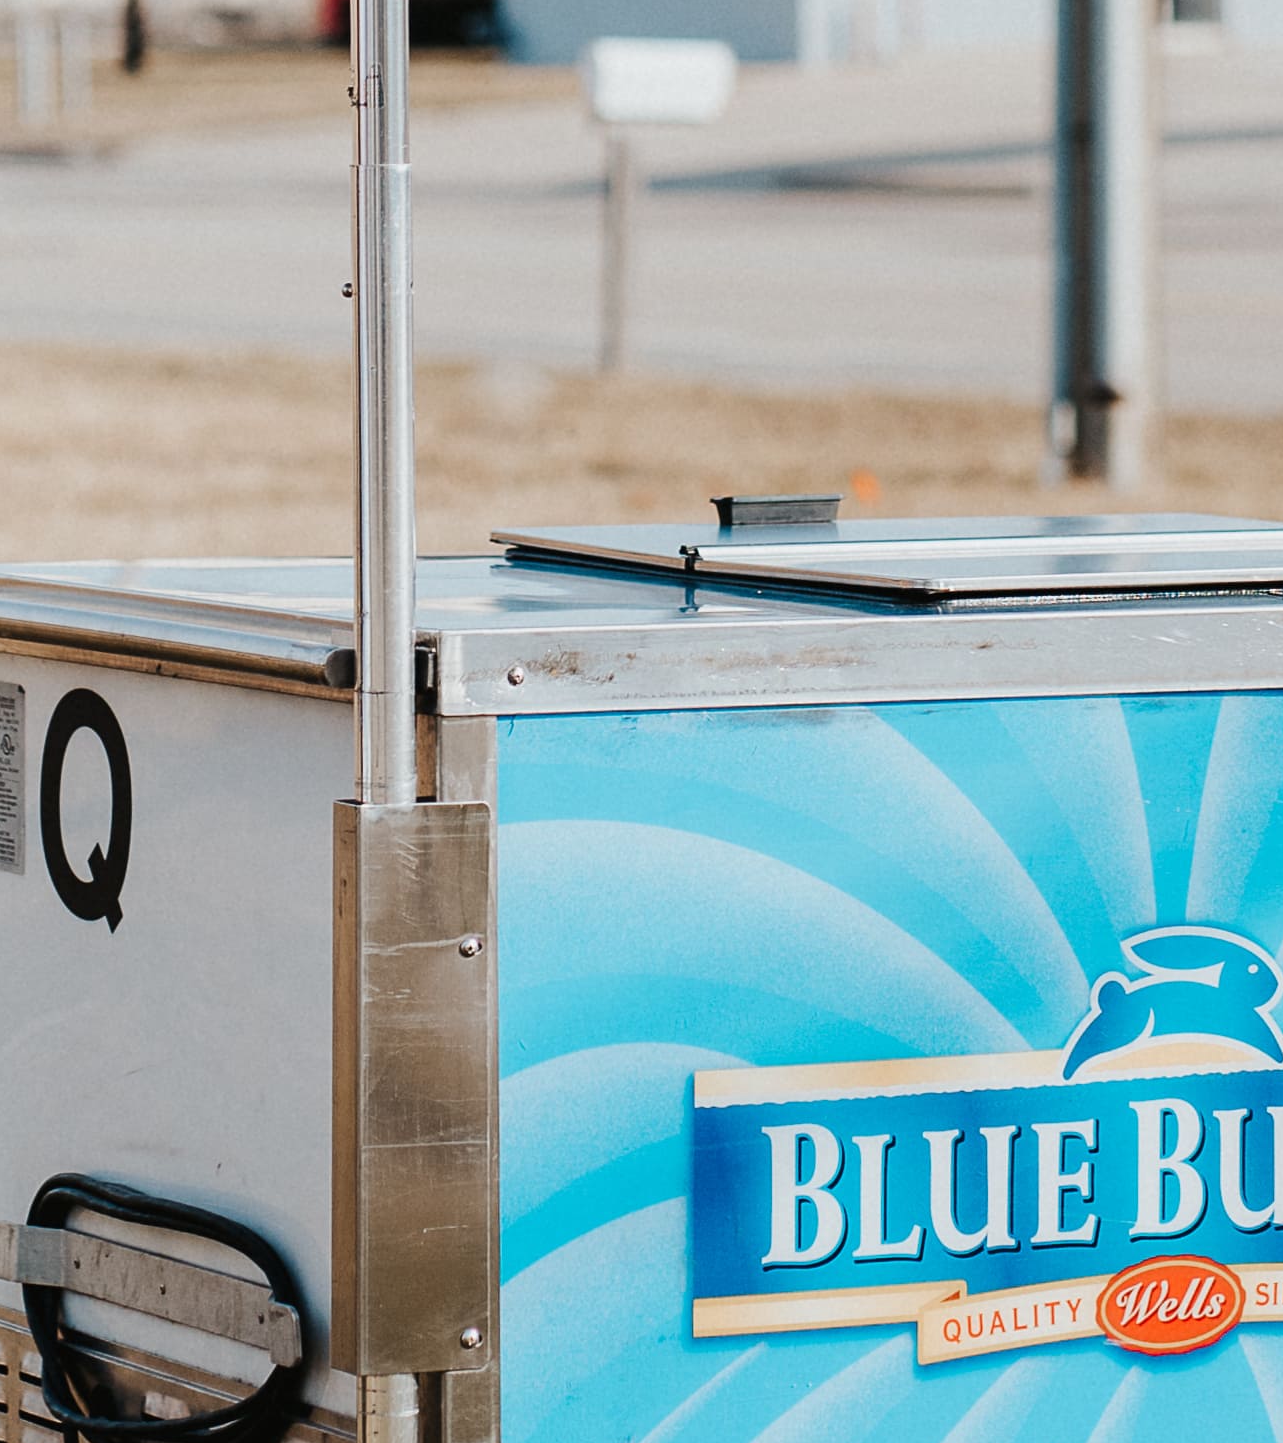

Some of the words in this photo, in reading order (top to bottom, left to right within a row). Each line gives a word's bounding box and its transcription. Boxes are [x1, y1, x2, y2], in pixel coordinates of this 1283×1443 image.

[39, 687, 133, 934] Q
[759, 1116, 1102, 1271] BLUE
[942, 1297, 1083, 1345] QUALITY
[1115, 1274, 1228, 1327] Wells
